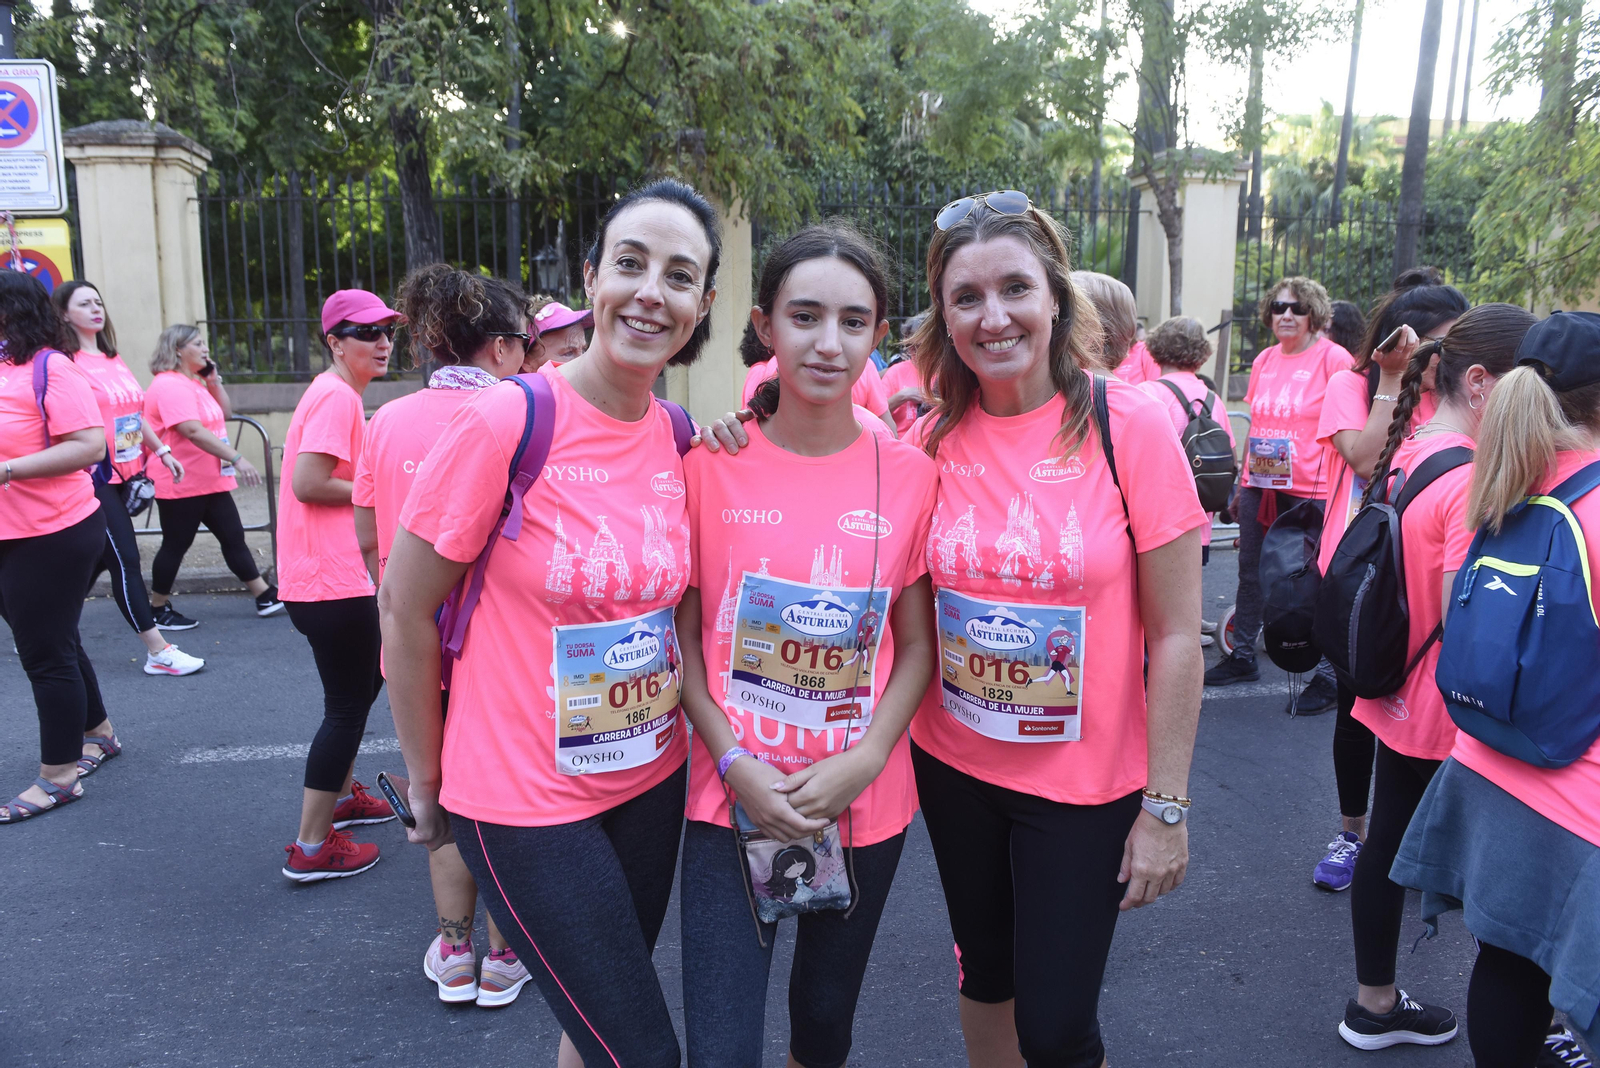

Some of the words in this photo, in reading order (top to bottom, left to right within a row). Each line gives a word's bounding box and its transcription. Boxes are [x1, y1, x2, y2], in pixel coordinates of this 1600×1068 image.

[1260, 427, 1300, 440] DORSAL
[942, 460, 985, 477] OYSHO
[1255, 457, 1274, 468] 016
[722, 509, 783, 524] OYSHO
[749, 596, 774, 608] SUMA
[757, 592, 776, 600] DORSAL
[785, 608, 849, 629] ASTURIANA
[797, 609, 824, 617] CENTRAL
[944, 607, 961, 621] SUMA
[969, 623, 1031, 645] ASTURIANA
[978, 624, 1000, 632] CENTRAL
[567, 648, 596, 658] SUMA
[608, 643, 658, 666] ASTURIANA
[619, 643, 640, 652] CENTRAL
[780, 639, 844, 671] 016
[969, 653, 1030, 685] 016
[793, 673, 826, 688] 1868
[608, 671, 660, 708] 016
[761, 678, 796, 696] CARRERA
[798, 689, 810, 699] DE
[811, 691, 823, 700] LA
[824, 690, 847, 701] MUJER
[981, 686, 1013, 701] 1829
[740, 690, 786, 713] OYSHO
[959, 690, 986, 708] CARRERA
[988, 701, 999, 711] DE
[1001, 703, 1012, 713] LA
[1014, 705, 1044, 715] MUJER
[1451, 690, 1484, 708] TENTH
[625, 706, 651, 725] 1867
[949, 699, 981, 724] OYSHO
[592, 729, 632, 743] CARRERA
[633, 726, 643, 736] DE
[643, 723, 652, 732] LA
[652, 714, 668, 729] MUJER
[571, 750, 624, 766] OYSHO
[757, 752, 770, 761] DE
[771, 753, 782, 762] LA
[783, 754, 814, 765] MUJER
